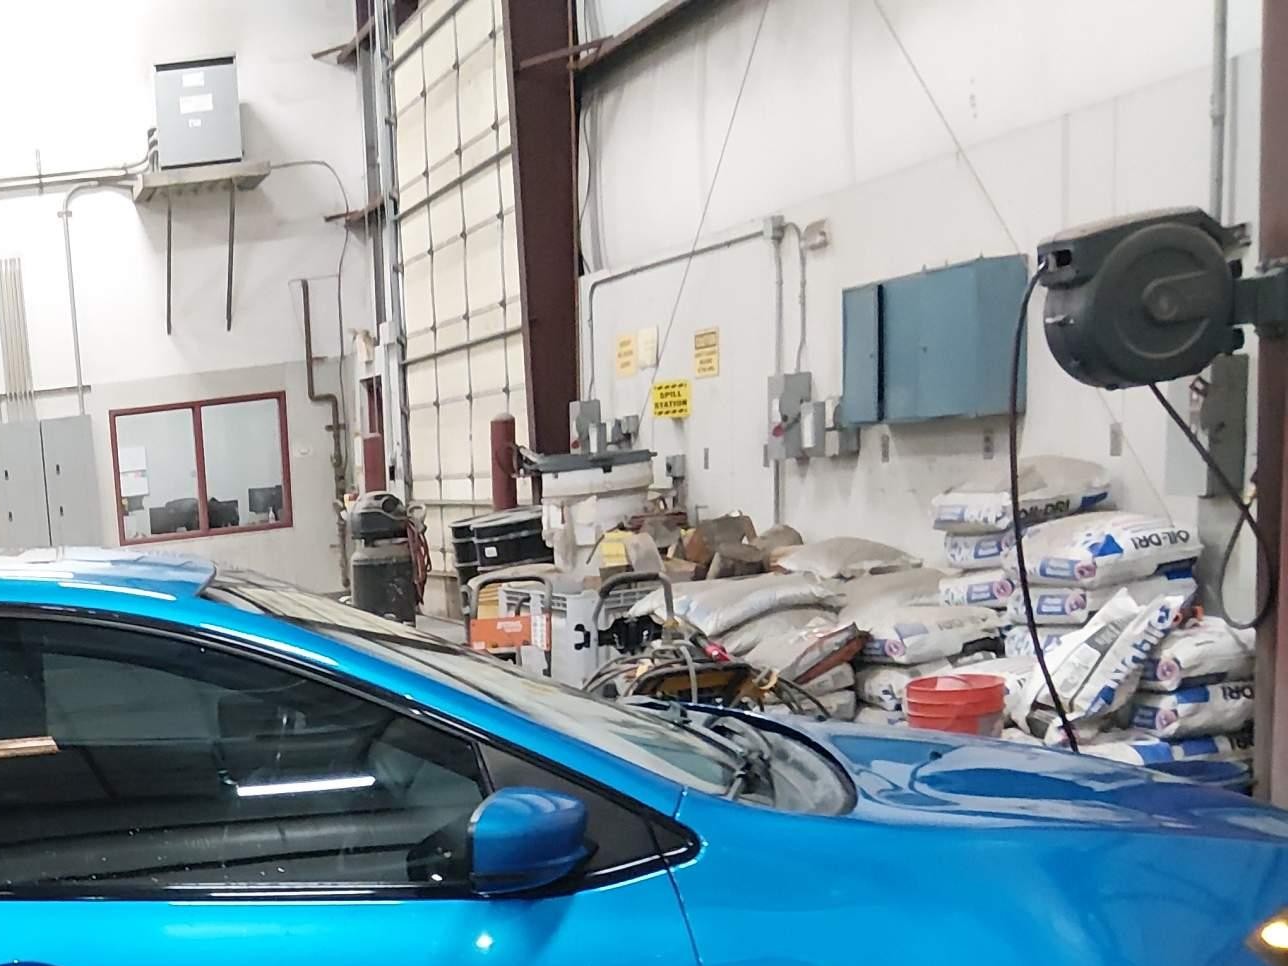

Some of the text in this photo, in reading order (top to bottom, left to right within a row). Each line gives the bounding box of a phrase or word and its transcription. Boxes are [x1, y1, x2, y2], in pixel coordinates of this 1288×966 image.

[659, 390, 682, 399] SPILL
[654, 399, 688, 409] STATION
[1130, 529, 1190, 550] OIL-DRI
